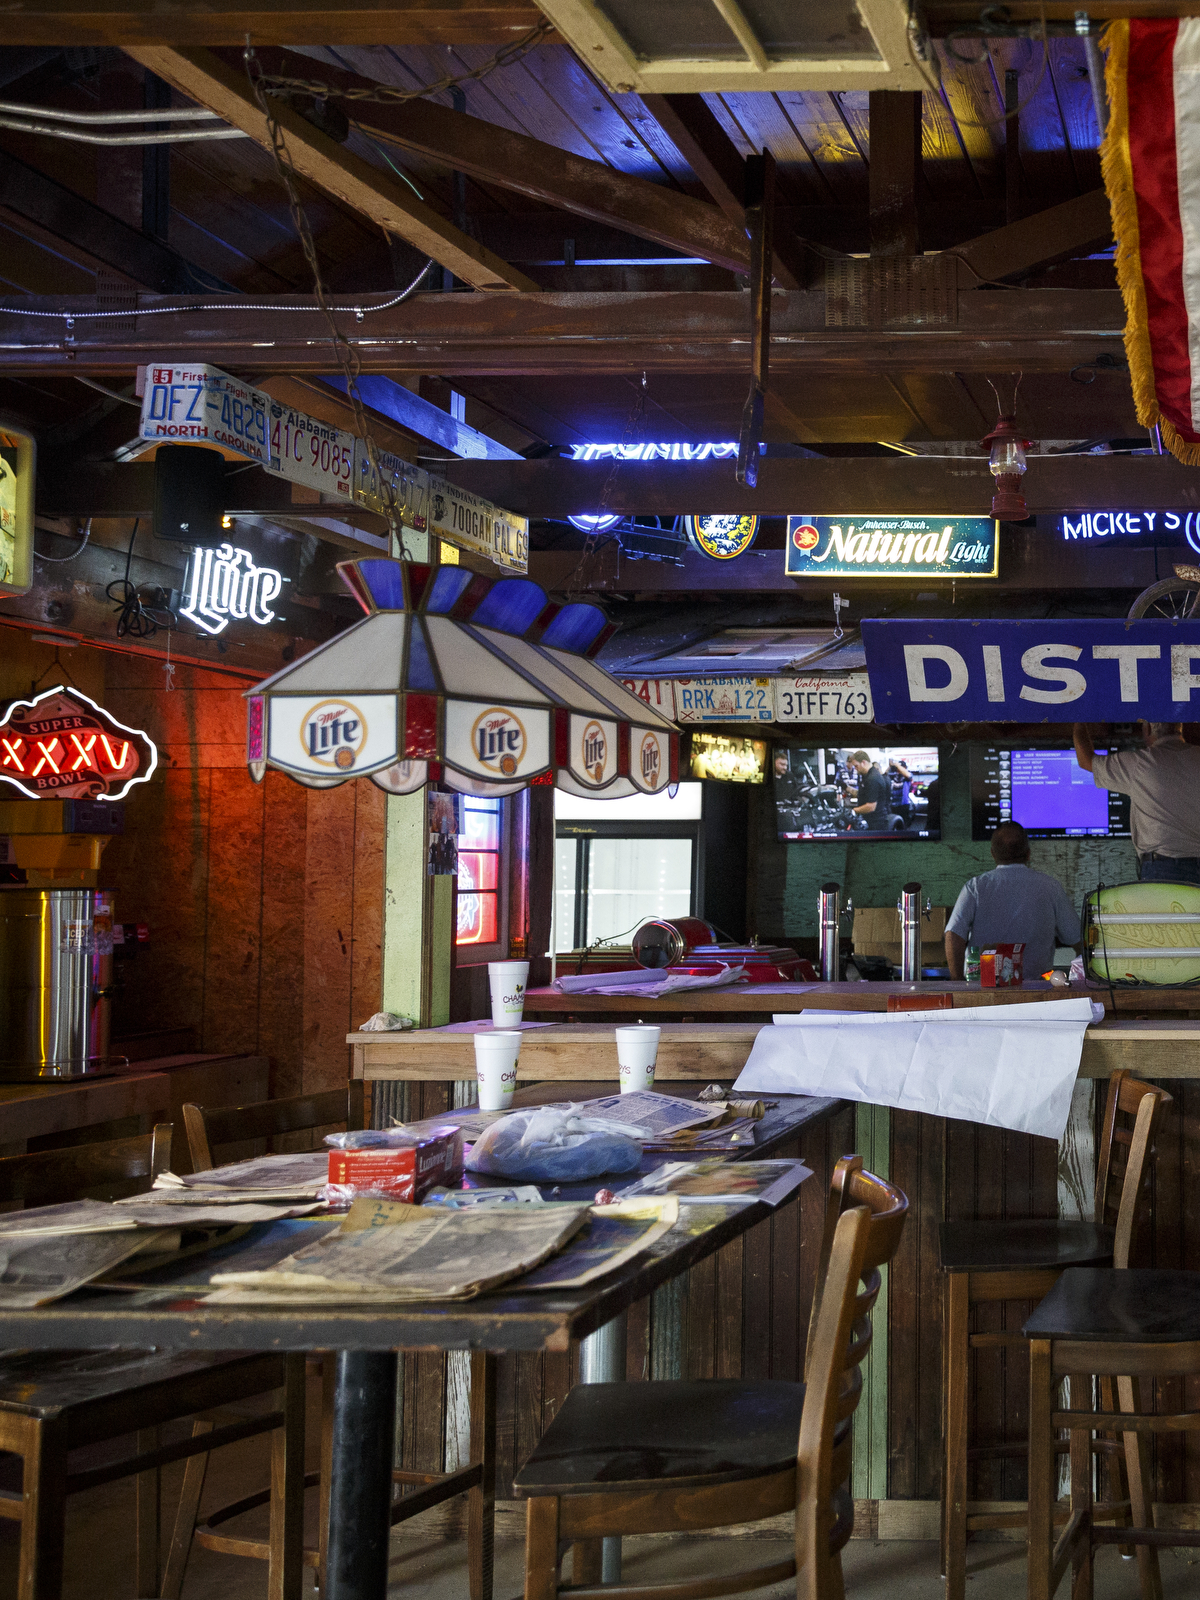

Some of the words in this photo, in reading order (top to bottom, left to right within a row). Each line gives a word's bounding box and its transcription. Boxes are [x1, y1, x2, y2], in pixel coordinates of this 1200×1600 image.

[160, 370, 170, 383] 5
[182, 372, 208, 382] First
[225, 383, 248, 401] Flight
[156, 424, 209, 437] NORTH
[214, 430, 263, 460] CAROLINA
[287, 413, 336, 442] Alabama
[271, 420, 304, 462] 41C
[310, 436, 351, 480] 9085
[446, 485, 478, 507] INDIANA
[811, 525, 953, 565] Natural
[949, 541, 991, 563] Light
[179, 543, 282, 635] Lite
[695, 677, 753, 686] ALABAMA
[794, 677, 856, 694] California
[682, 689, 716, 710] RRK
[734, 689, 767, 710] 122
[782, 691, 868, 716] 3TFF763
[29, 716, 84, 734] SUPER
[316, 707, 348, 724] Miller
[307, 718, 360, 757] Lite
[478, 725, 521, 762] Lite
[1, 733, 130, 777] XXXV
[584, 738, 605, 770] Lite
[642, 748, 659, 778] Lite
[37, 770, 87, 789] BOWL
